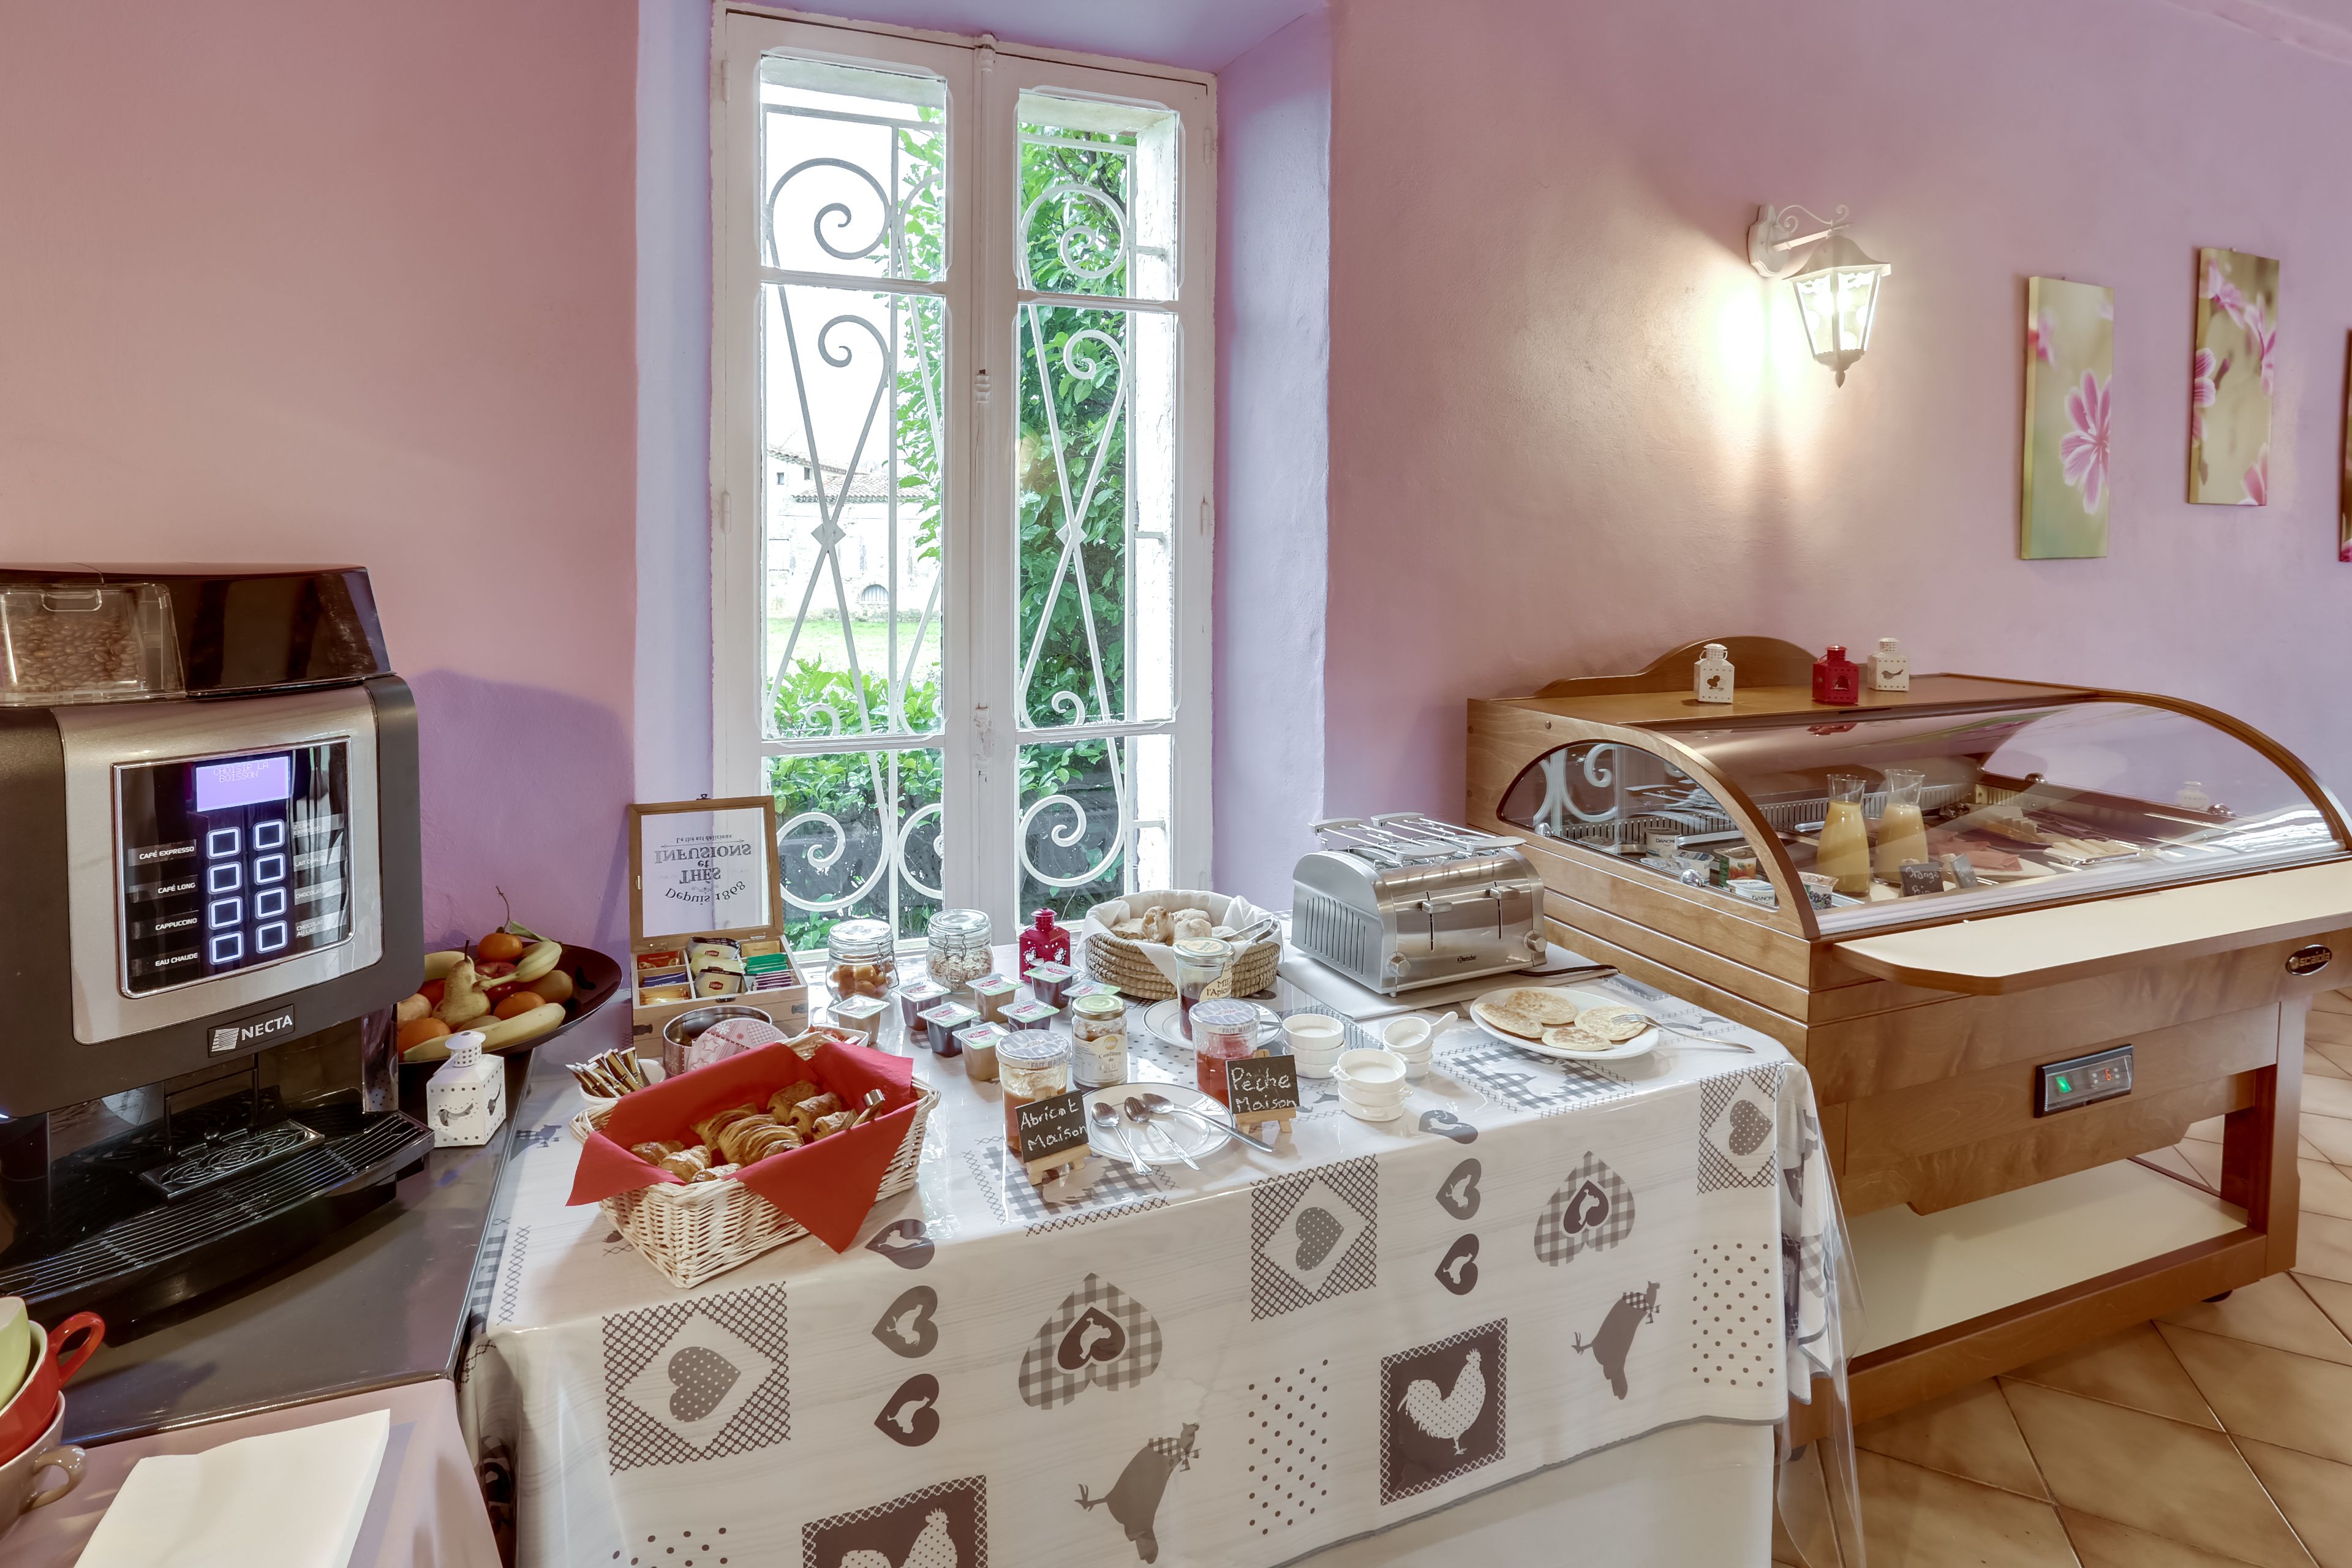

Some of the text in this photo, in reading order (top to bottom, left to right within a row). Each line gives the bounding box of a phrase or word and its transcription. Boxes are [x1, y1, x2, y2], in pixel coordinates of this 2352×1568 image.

[214, 764, 252, 775] CHOISIR
[219, 771, 258, 783] BOISSON
[139, 846, 195, 860] CAFÉ EXPRESSO
[157, 882, 196, 894] CAFÉ LONG
[295, 888, 322, 899] CHOCOLAT
[155, 918, 197, 931] CAPPUCCINO
[296, 919, 323, 931] CHOCOLAT
[170, 952, 198, 963] CHAUDE
[1217, 977, 1232, 988] MIE
[241, 1014, 293, 1041] NECTA
[1231, 1068, 1292, 1091] Pêche
[1235, 1095, 1297, 1113] Maison
[1020, 1098, 1079, 1131] Abricot
[1027, 1125, 1088, 1152] Maison
